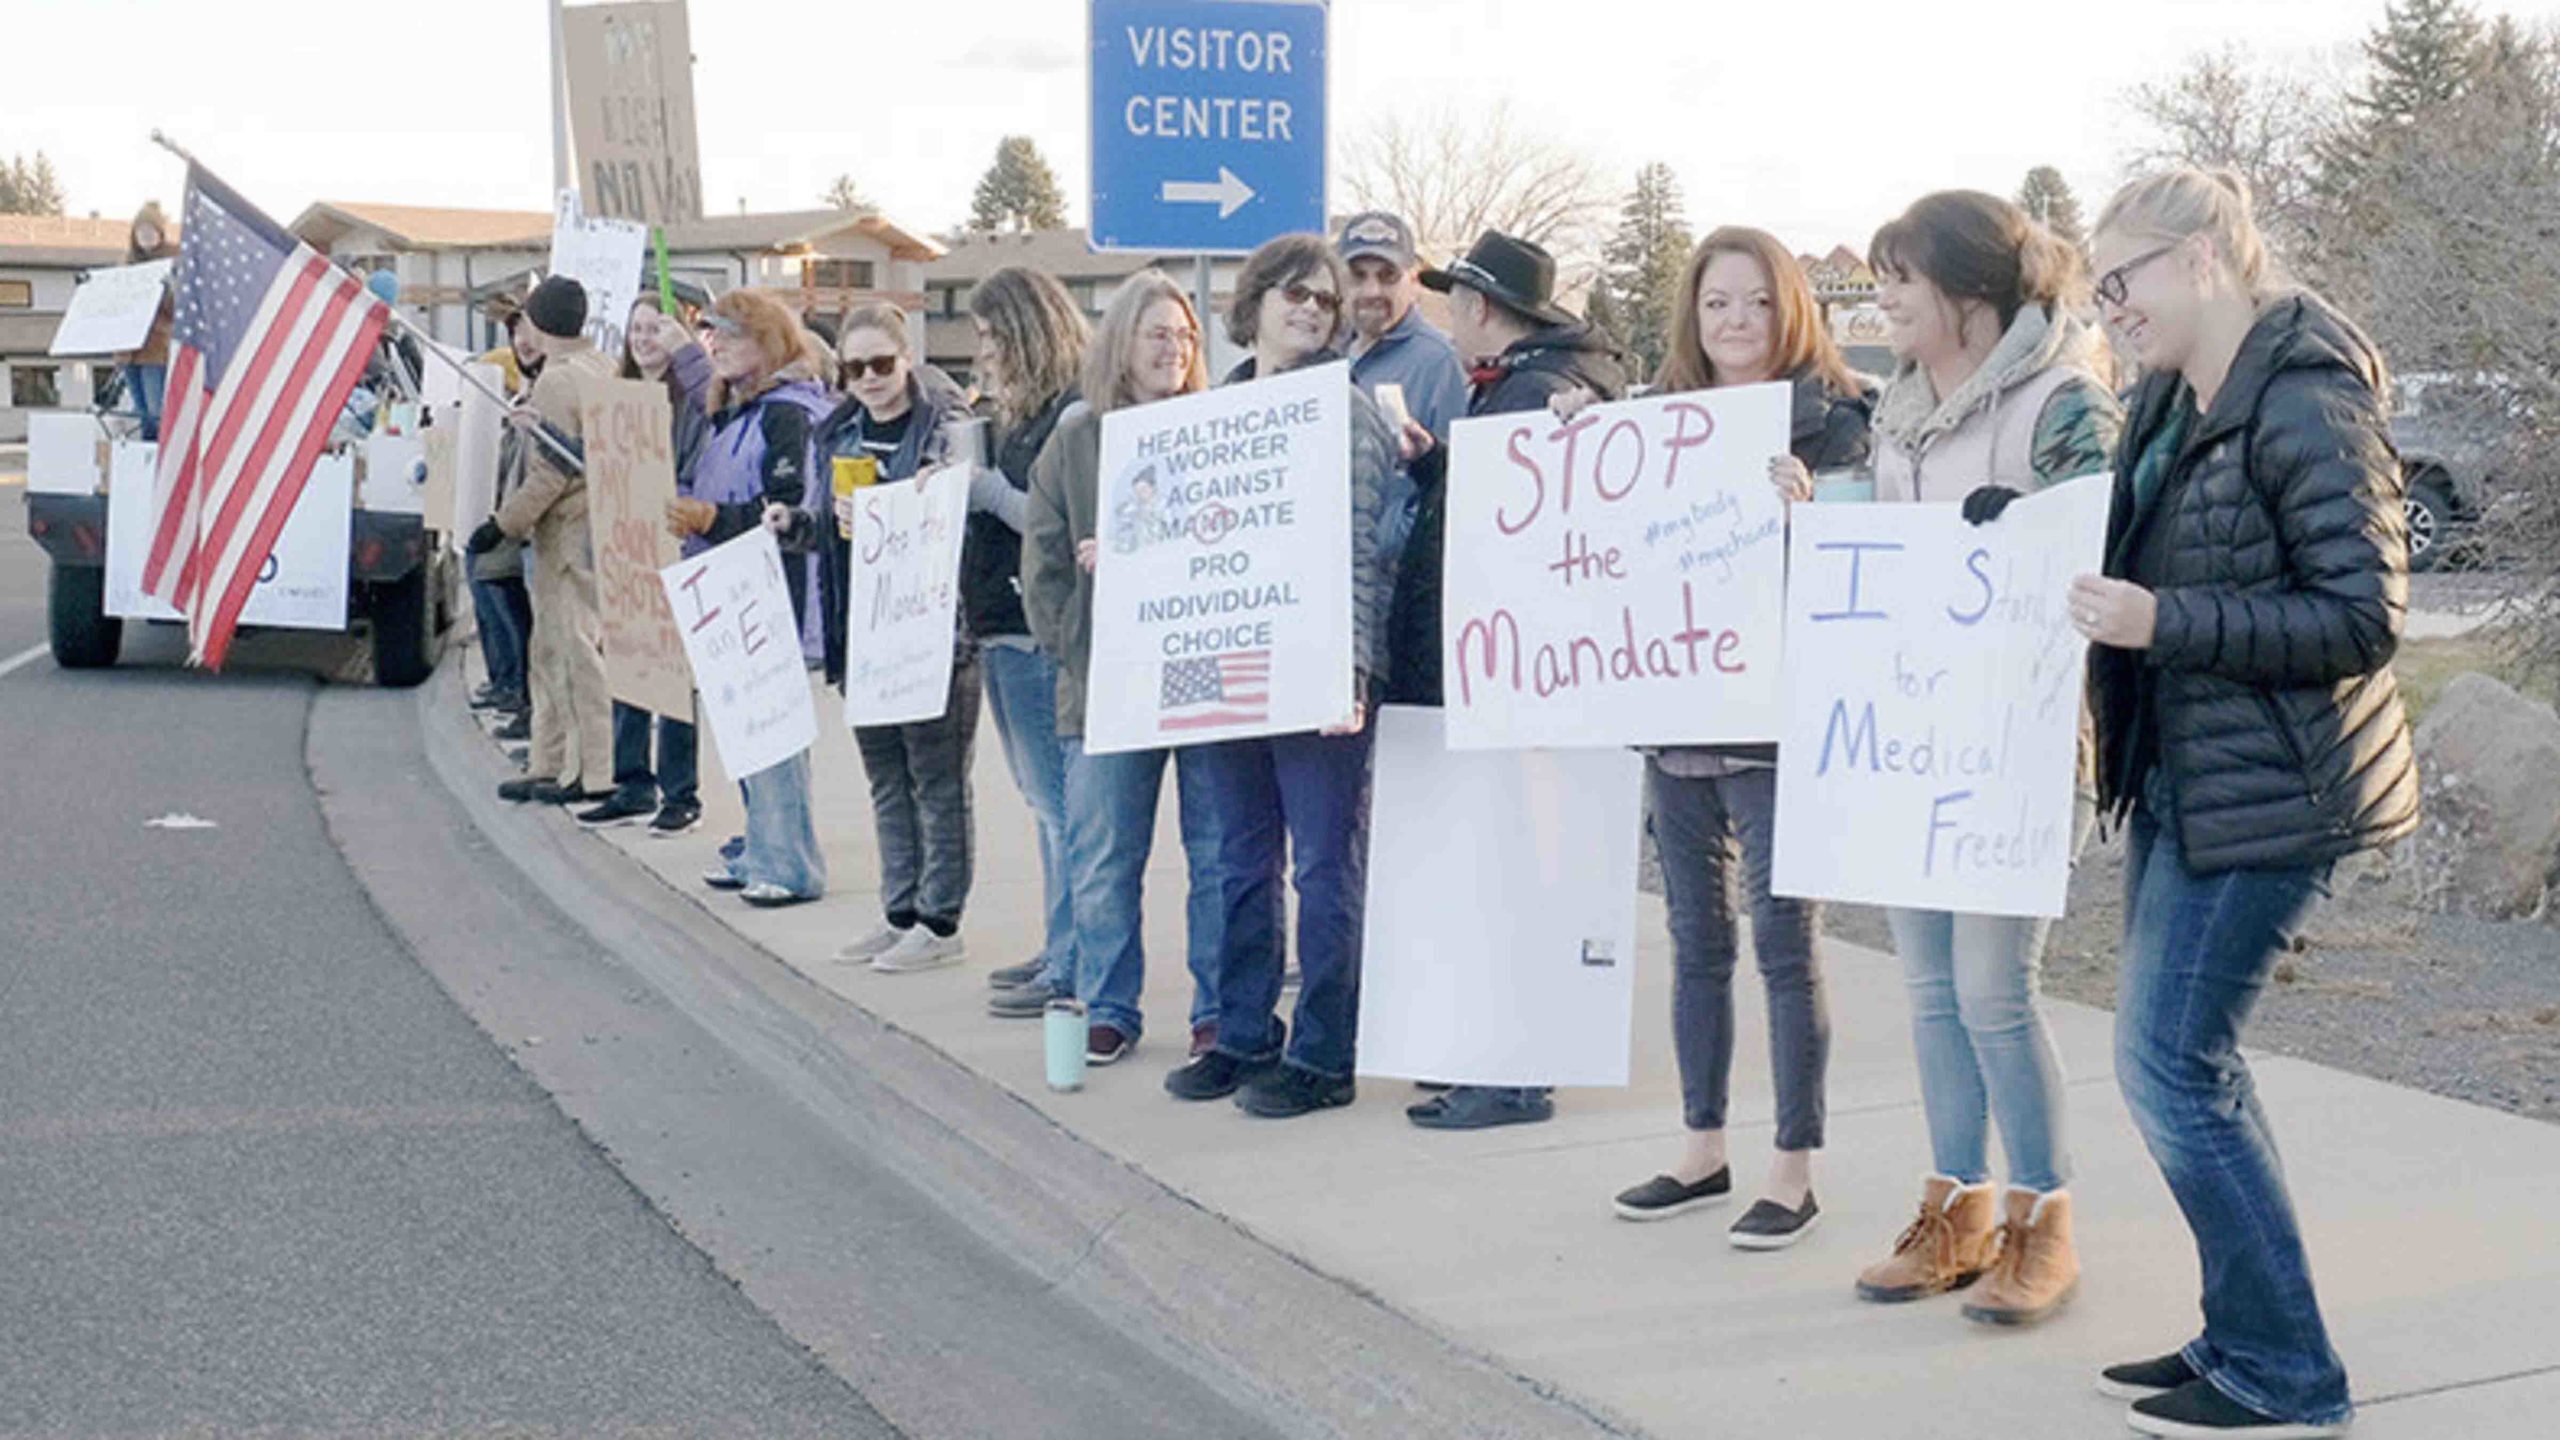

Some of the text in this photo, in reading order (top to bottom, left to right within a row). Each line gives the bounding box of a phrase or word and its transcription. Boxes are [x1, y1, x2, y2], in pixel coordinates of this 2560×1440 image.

[1127, 26, 1292, 73] VISITOR
[1125, 95, 1292, 141] CENTER
[1137, 398, 1320, 458] HEALTHCARE
[1165, 432, 1289, 476] WORKER
[1496, 402, 1715, 535] STOP
[1166, 467, 1289, 508] AGAINST
[1159, 501, 1295, 542] MANDATE
[1189, 550, 1250, 580] PRO
[1549, 529, 1626, 586] the
[680, 564, 721, 634] I
[1137, 583, 1299, 622] INDIVIDUAL
[1811, 542, 1905, 622] I
[1162, 621, 1272, 656] CHOICE
[1457, 581, 1746, 708] Mandate
[1894, 651, 1949, 698] for
[1817, 699, 2013, 779] Medical
